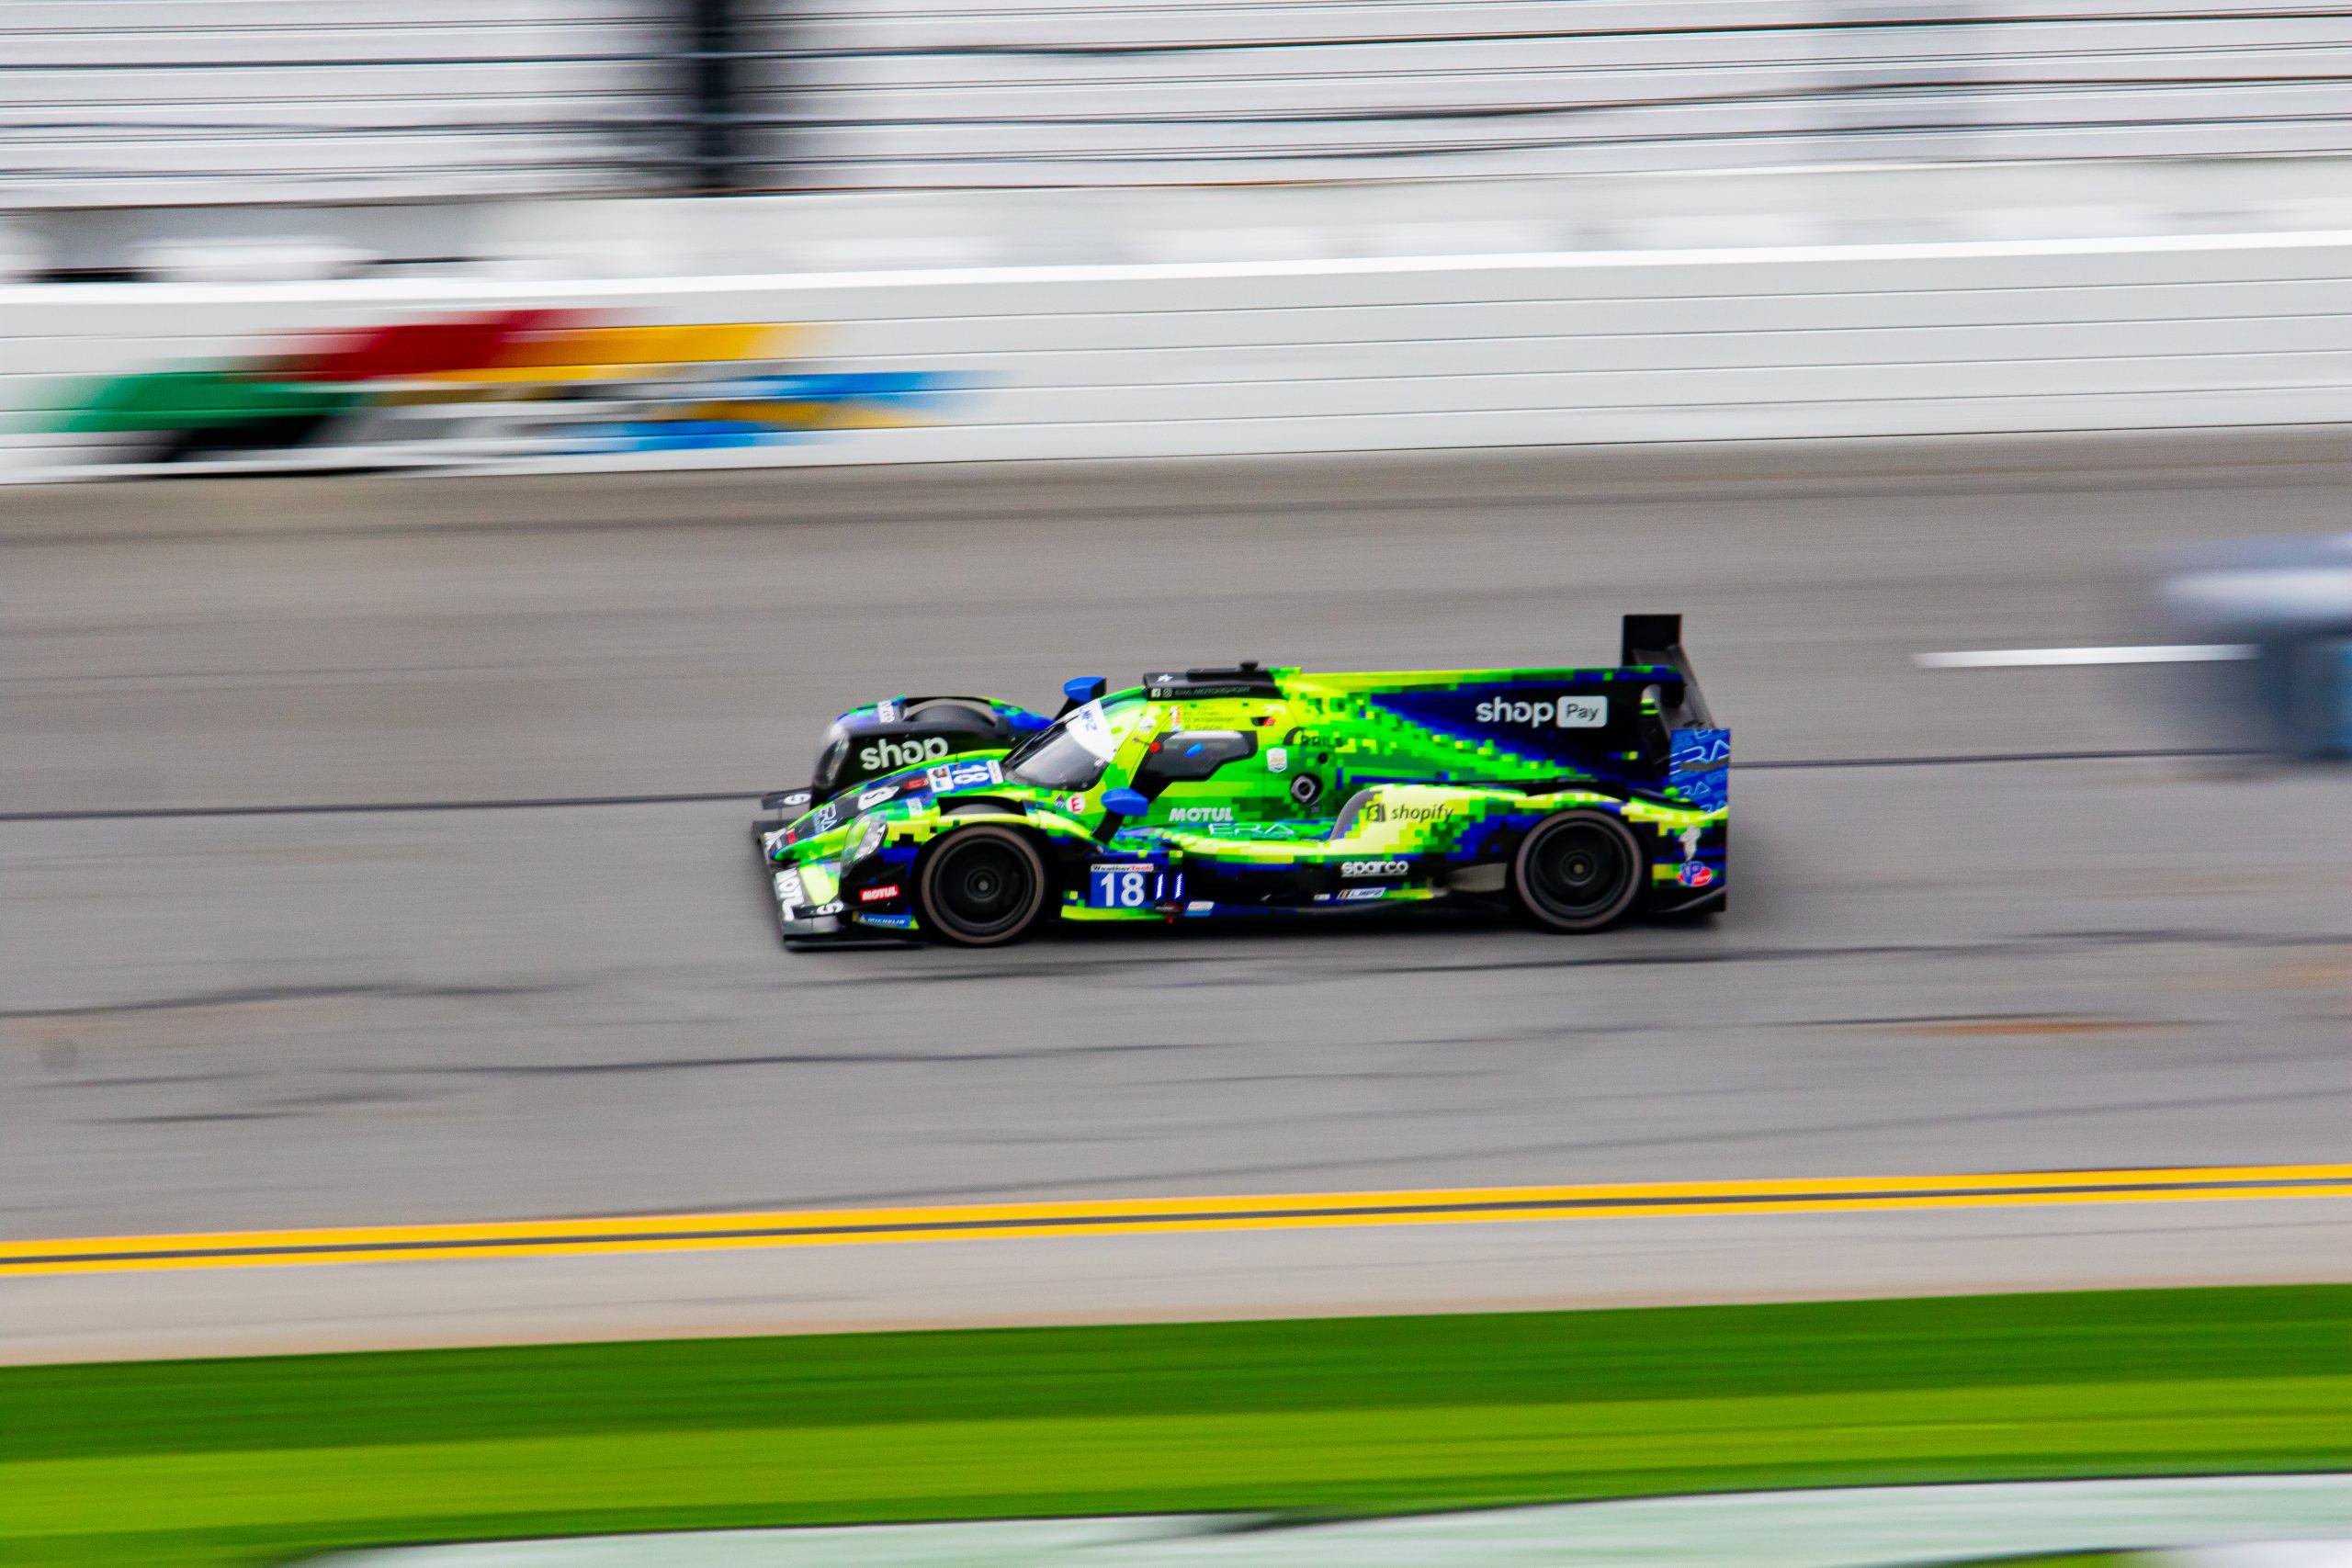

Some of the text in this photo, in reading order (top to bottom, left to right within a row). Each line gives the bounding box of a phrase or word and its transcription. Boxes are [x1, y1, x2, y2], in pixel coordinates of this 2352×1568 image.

[1476, 696, 1600, 728] shop Pay
[860, 737, 949, 771] shop
[951, 764, 990, 784] 18
[1169, 807, 1233, 822] MOTUL
[1391, 804, 1454, 822] shopify
[1340, 860, 1408, 876] sparco
[862, 886, 898, 901] MOTUL
[1100, 873, 1146, 907] 18
